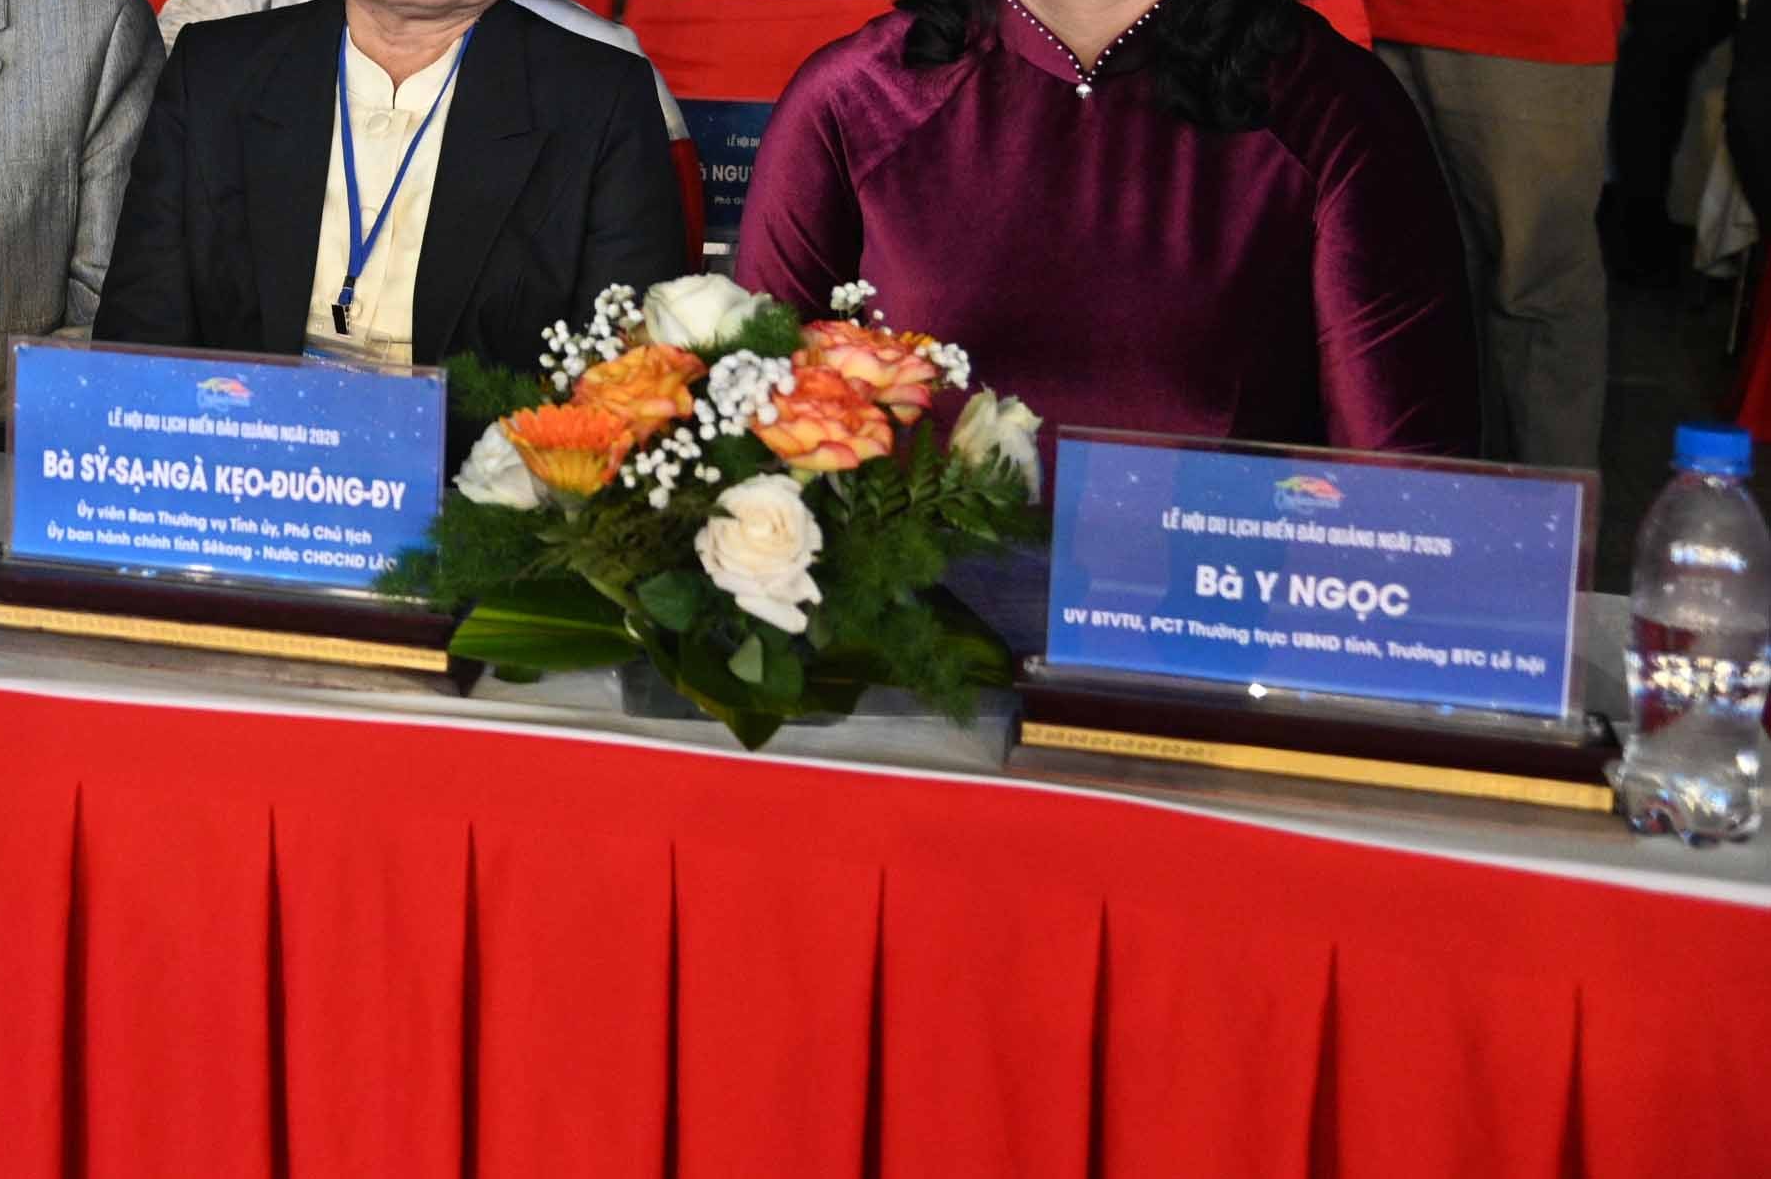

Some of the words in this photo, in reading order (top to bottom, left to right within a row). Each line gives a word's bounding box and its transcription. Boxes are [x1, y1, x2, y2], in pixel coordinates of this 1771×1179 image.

[712, 164, 753, 182] NGU
[108, 405, 123, 428] LỄ
[124, 409, 143, 432] HỘI
[144, 412, 160, 431] DU
[162, 414, 187, 435] LỊCH
[309, 427, 340, 447] 2026
[43, 449, 74, 480] Bà
[215, 465, 406, 511] KẸO-ĐUÔNG-ĐY
[97, 504, 126, 521] viên
[128, 507, 155, 523] Ban
[157, 510, 208, 532] Thường
[210, 518, 227, 534] vụ
[284, 523, 310, 539] Phó
[313, 524, 342, 542] Chủ
[345, 528, 372, 547] lịch
[1162, 506, 1181, 529] LỄ
[1182, 510, 1205, 534] HỘI
[1208, 515, 1228, 536] DU
[1229, 518, 1260, 539] LỊCH
[67, 526, 94, 542] ban
[96, 529, 131, 546] hành
[133, 532, 171, 550] chính
[263, 545, 299, 563] Nước
[302, 548, 366, 569] CHDCND
[1196, 564, 1244, 601] Bà
[1255, 570, 1279, 603] Y
[1289, 573, 1411, 622] NGỌC
[1063, 607, 1088, 624] UV
[1150, 616, 1184, 635] PCT
[1188, 619, 1249, 645] Thường
[1254, 627, 1288, 649] trực
[1292, 632, 1341, 652] UBND
[1451, 648, 1486, 667] BTC
